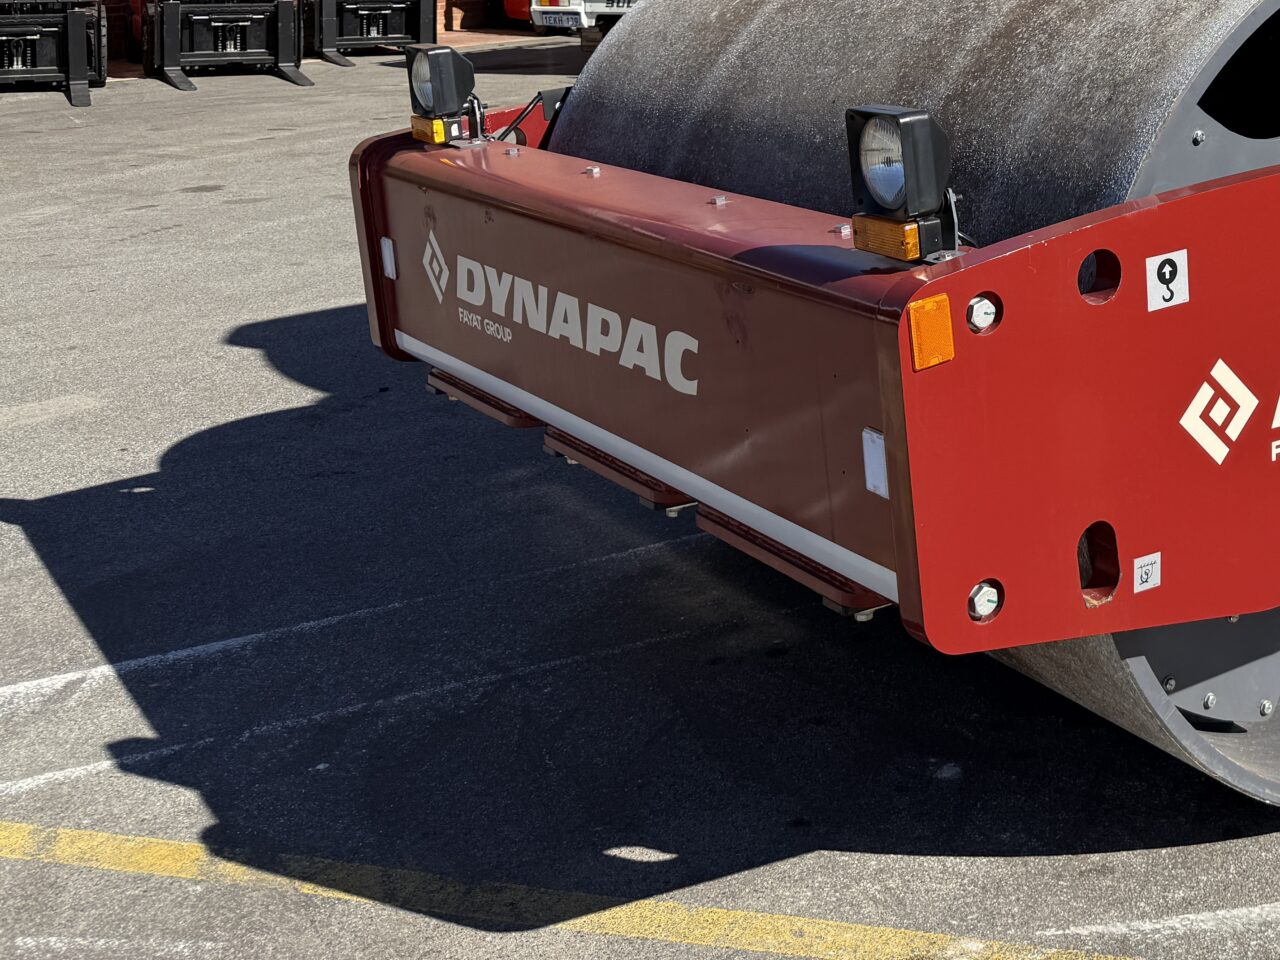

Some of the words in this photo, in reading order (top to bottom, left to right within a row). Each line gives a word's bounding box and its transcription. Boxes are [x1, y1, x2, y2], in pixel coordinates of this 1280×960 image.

[457, 255, 698, 395] DYNAPAC
[458, 308, 482, 331] FAYAT
[485, 319, 512, 343] GROUP
